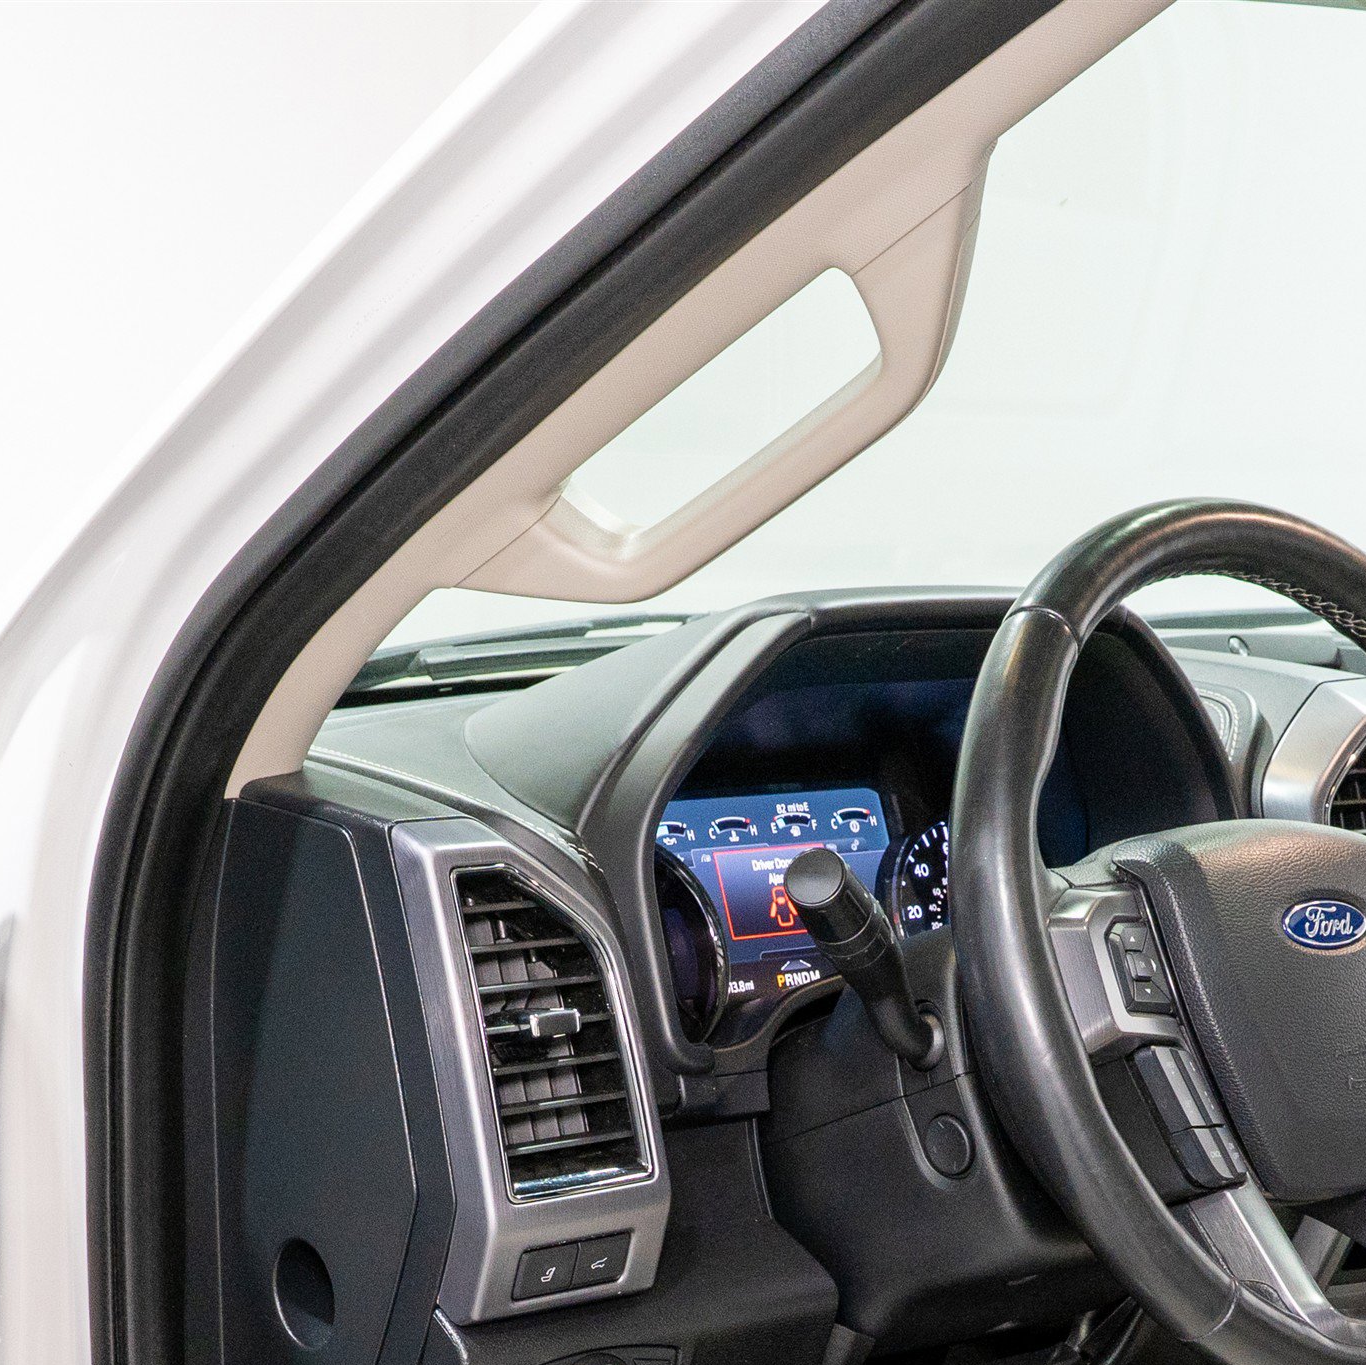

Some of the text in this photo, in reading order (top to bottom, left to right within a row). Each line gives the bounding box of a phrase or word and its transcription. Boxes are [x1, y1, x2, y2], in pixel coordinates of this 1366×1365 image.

[776, 804, 786, 814] 82
[770, 819, 817, 834] E F
[830, 815, 877, 830] C H
[685, 829, 695, 842] H
[709, 824, 758, 840] C H
[751, 859, 775, 871] Driver
[914, 863, 929, 877] 40
[907, 905, 923, 919] 20
[1304, 906, 1354, 938] Ford
